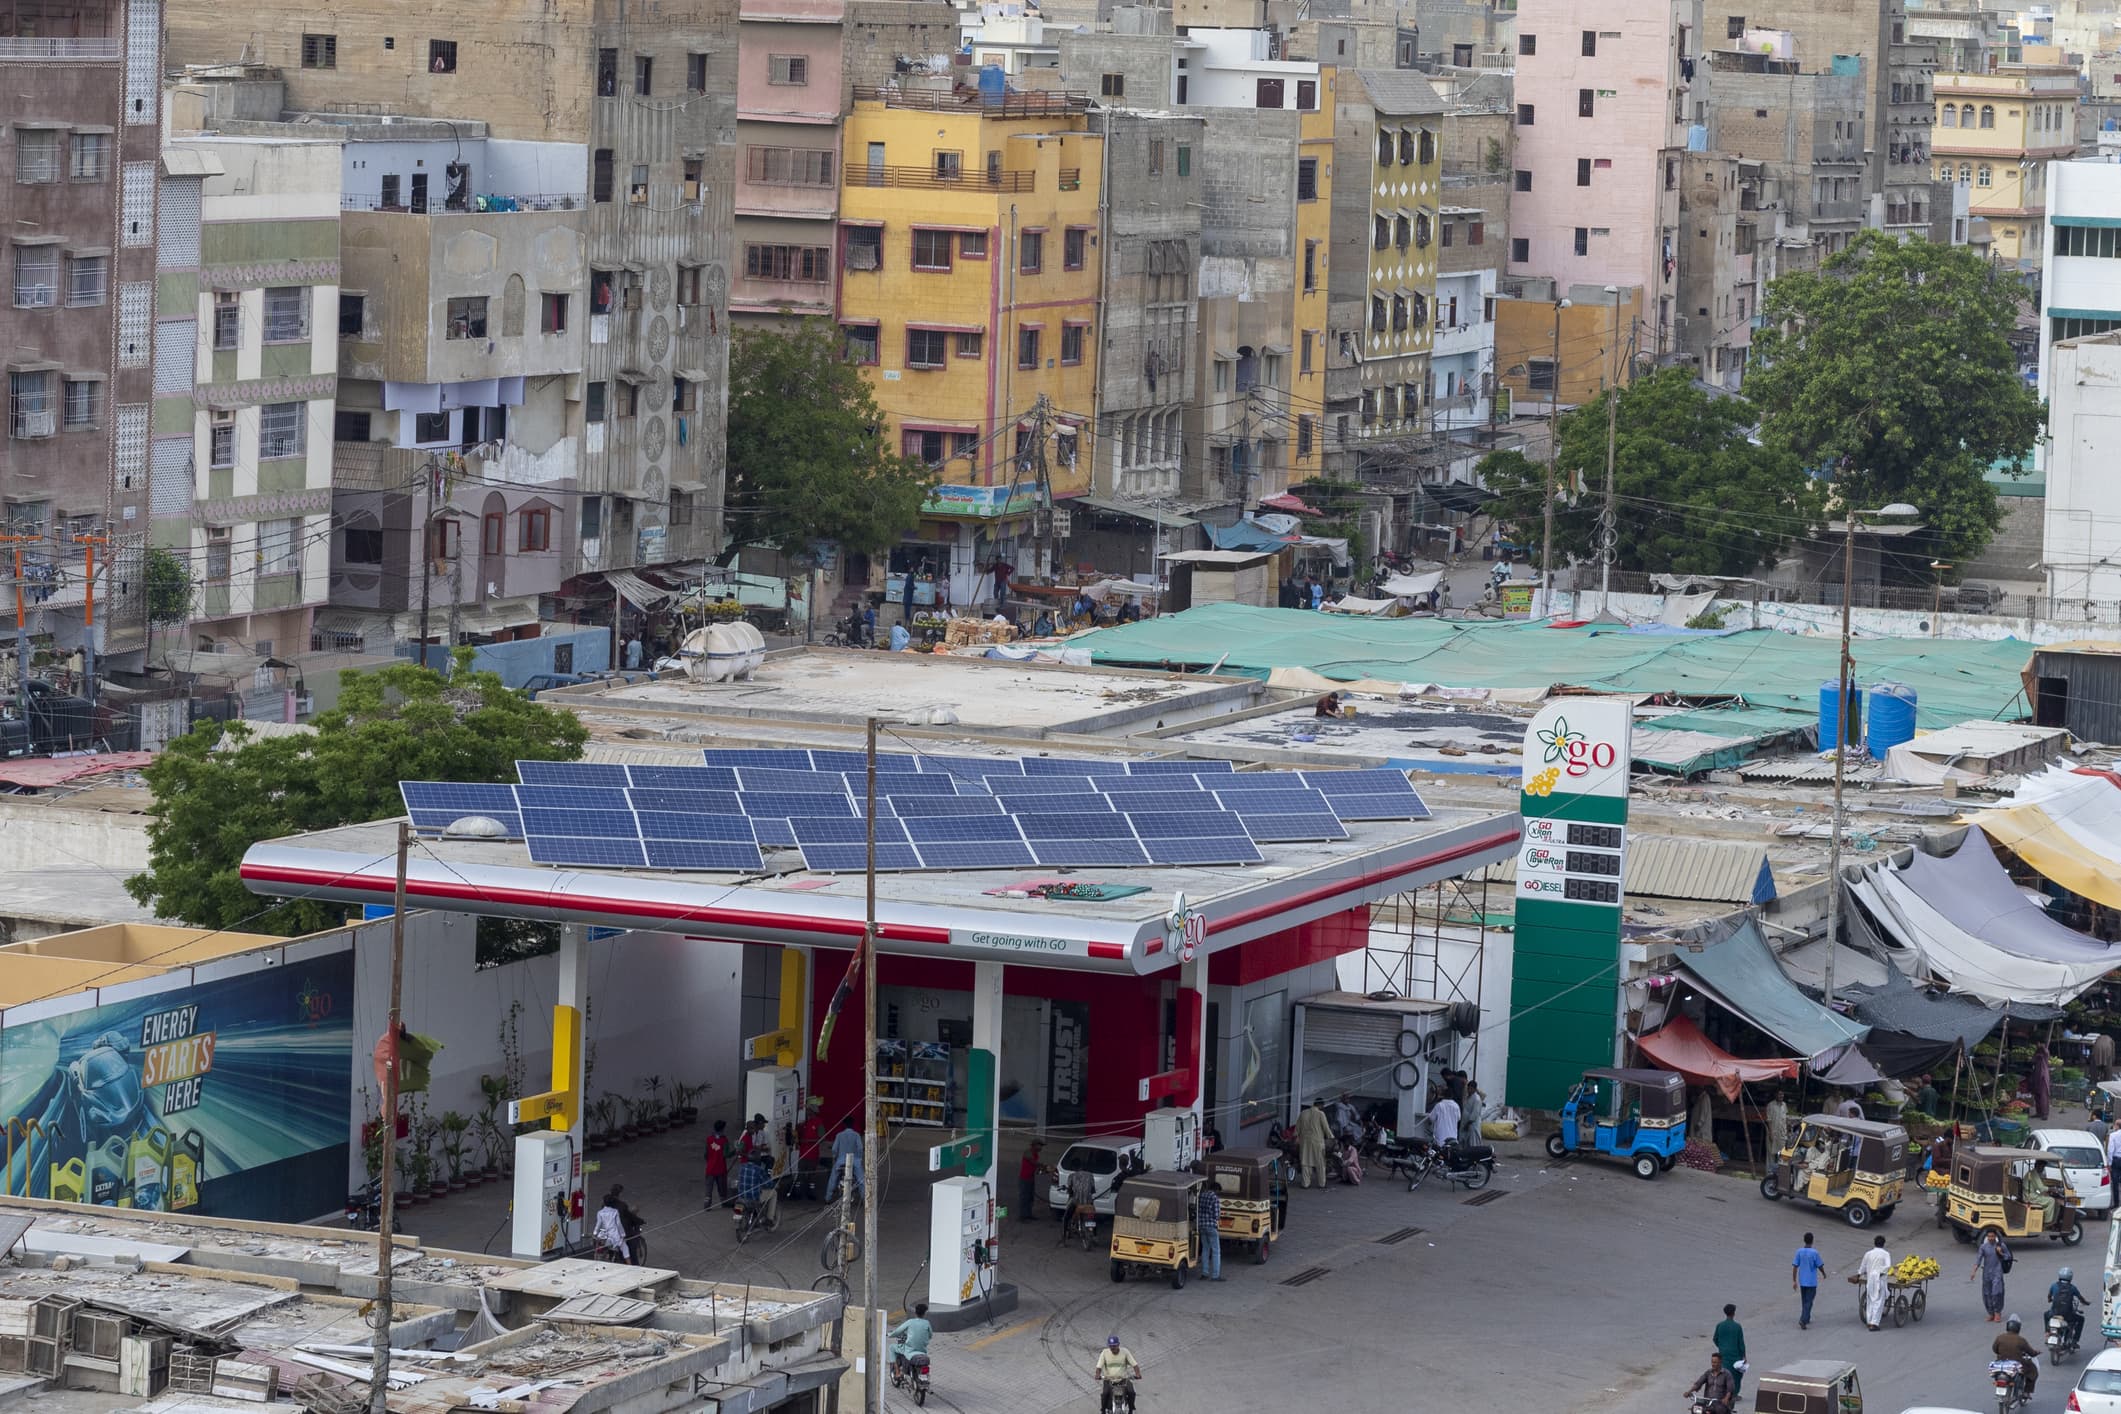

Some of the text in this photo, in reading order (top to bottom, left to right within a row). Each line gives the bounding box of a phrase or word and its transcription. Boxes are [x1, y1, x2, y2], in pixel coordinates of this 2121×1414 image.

[1566, 741, 1616, 777] go
[1538, 821, 1552, 830] GO
[1536, 849, 1549, 858] GO
[971, 932, 1067, 950] Get going with GO
[1183, 914, 1206, 962] go
[142, 1006, 198, 1046] ENERGY
[145, 1035, 212, 1085] STARTS
[1053, 1009, 1074, 1104] TRUST
[165, 1077, 202, 1113] HERE
